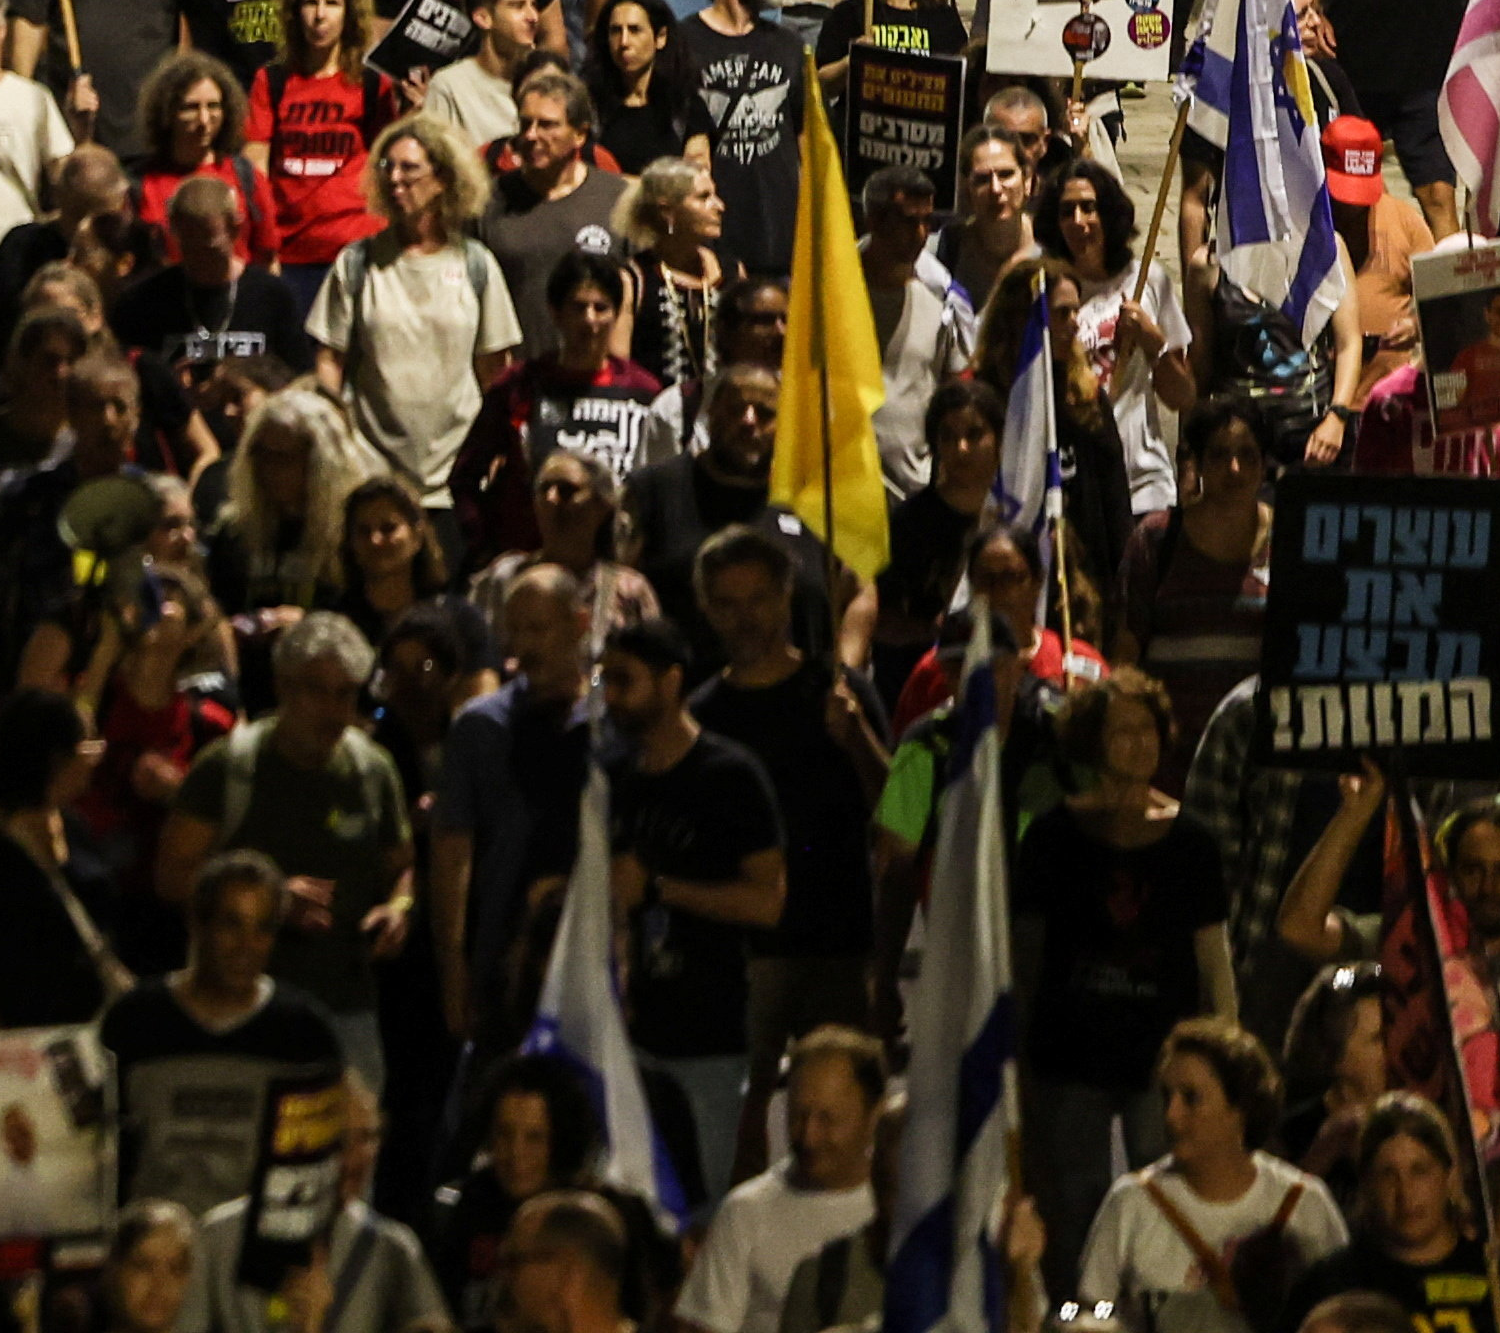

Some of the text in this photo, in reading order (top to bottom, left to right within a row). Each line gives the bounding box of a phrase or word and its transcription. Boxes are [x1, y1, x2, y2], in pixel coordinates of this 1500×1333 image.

[860, 110, 947, 145] מסרבים
[1302, 501, 1493, 569] עוצרים
[1341, 566, 1445, 627] את
[1291, 622, 1482, 682] מבצע
[1268, 678, 1493, 752] המוות!
